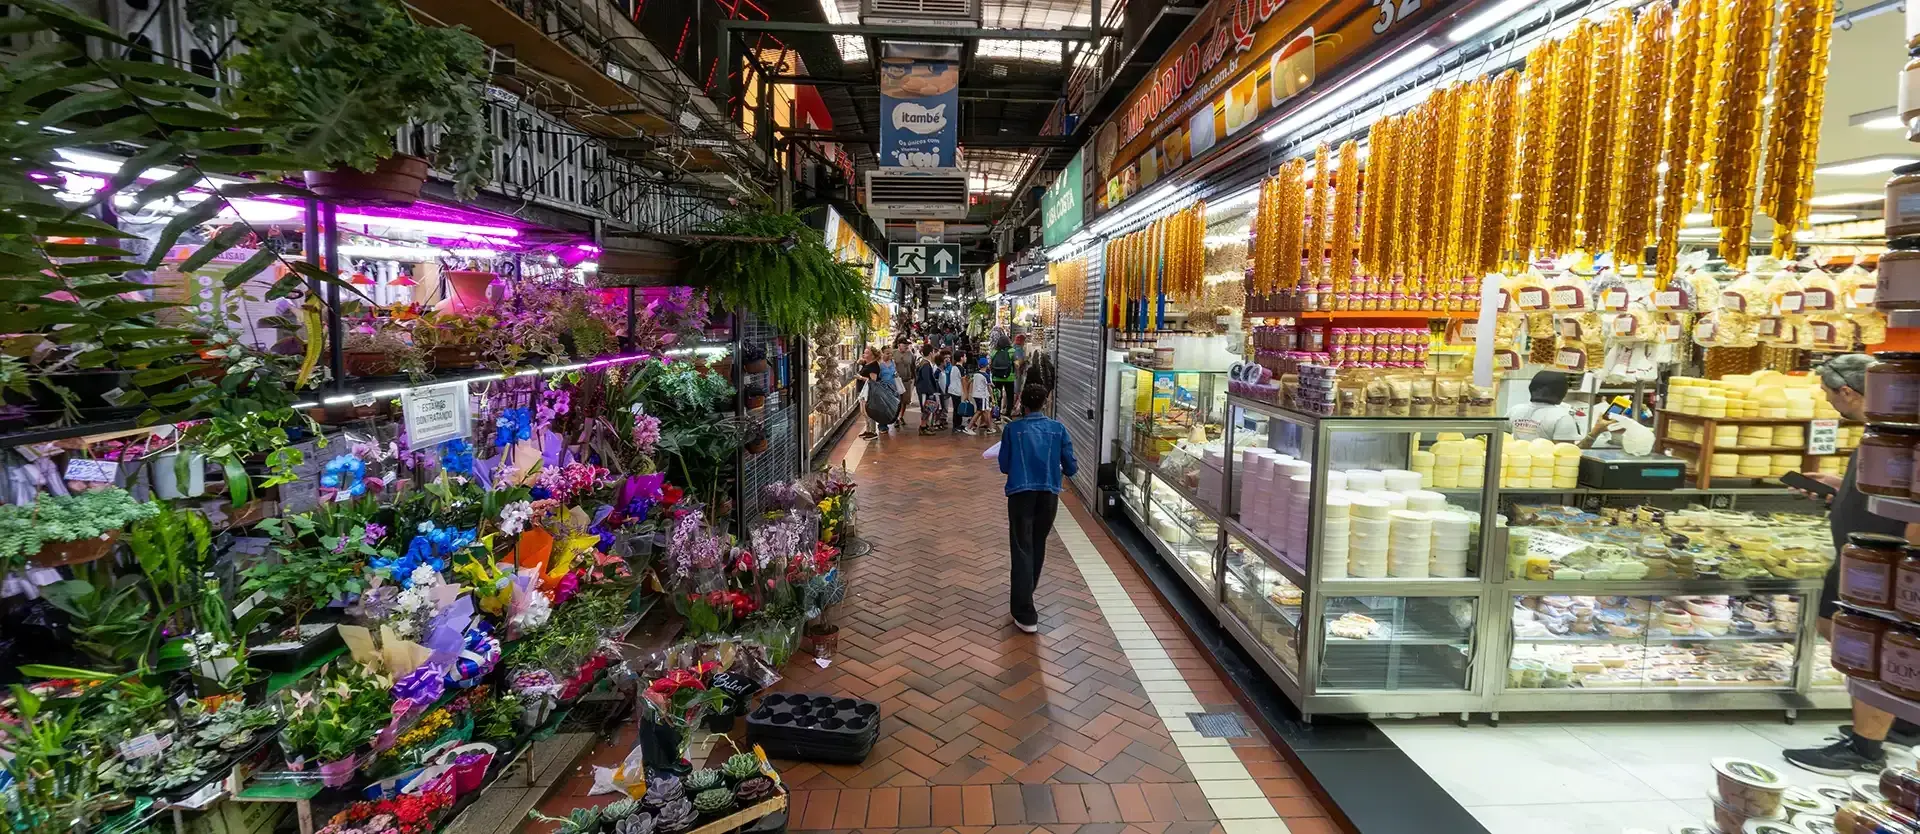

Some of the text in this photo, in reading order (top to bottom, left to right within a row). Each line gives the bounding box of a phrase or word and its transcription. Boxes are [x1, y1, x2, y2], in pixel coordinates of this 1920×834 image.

[1119, 42, 1200, 150] EMPÓRIO
[1202, 18, 1229, 74] do
[901, 111, 940, 124] itambé
[907, 138, 927, 146] únicos
